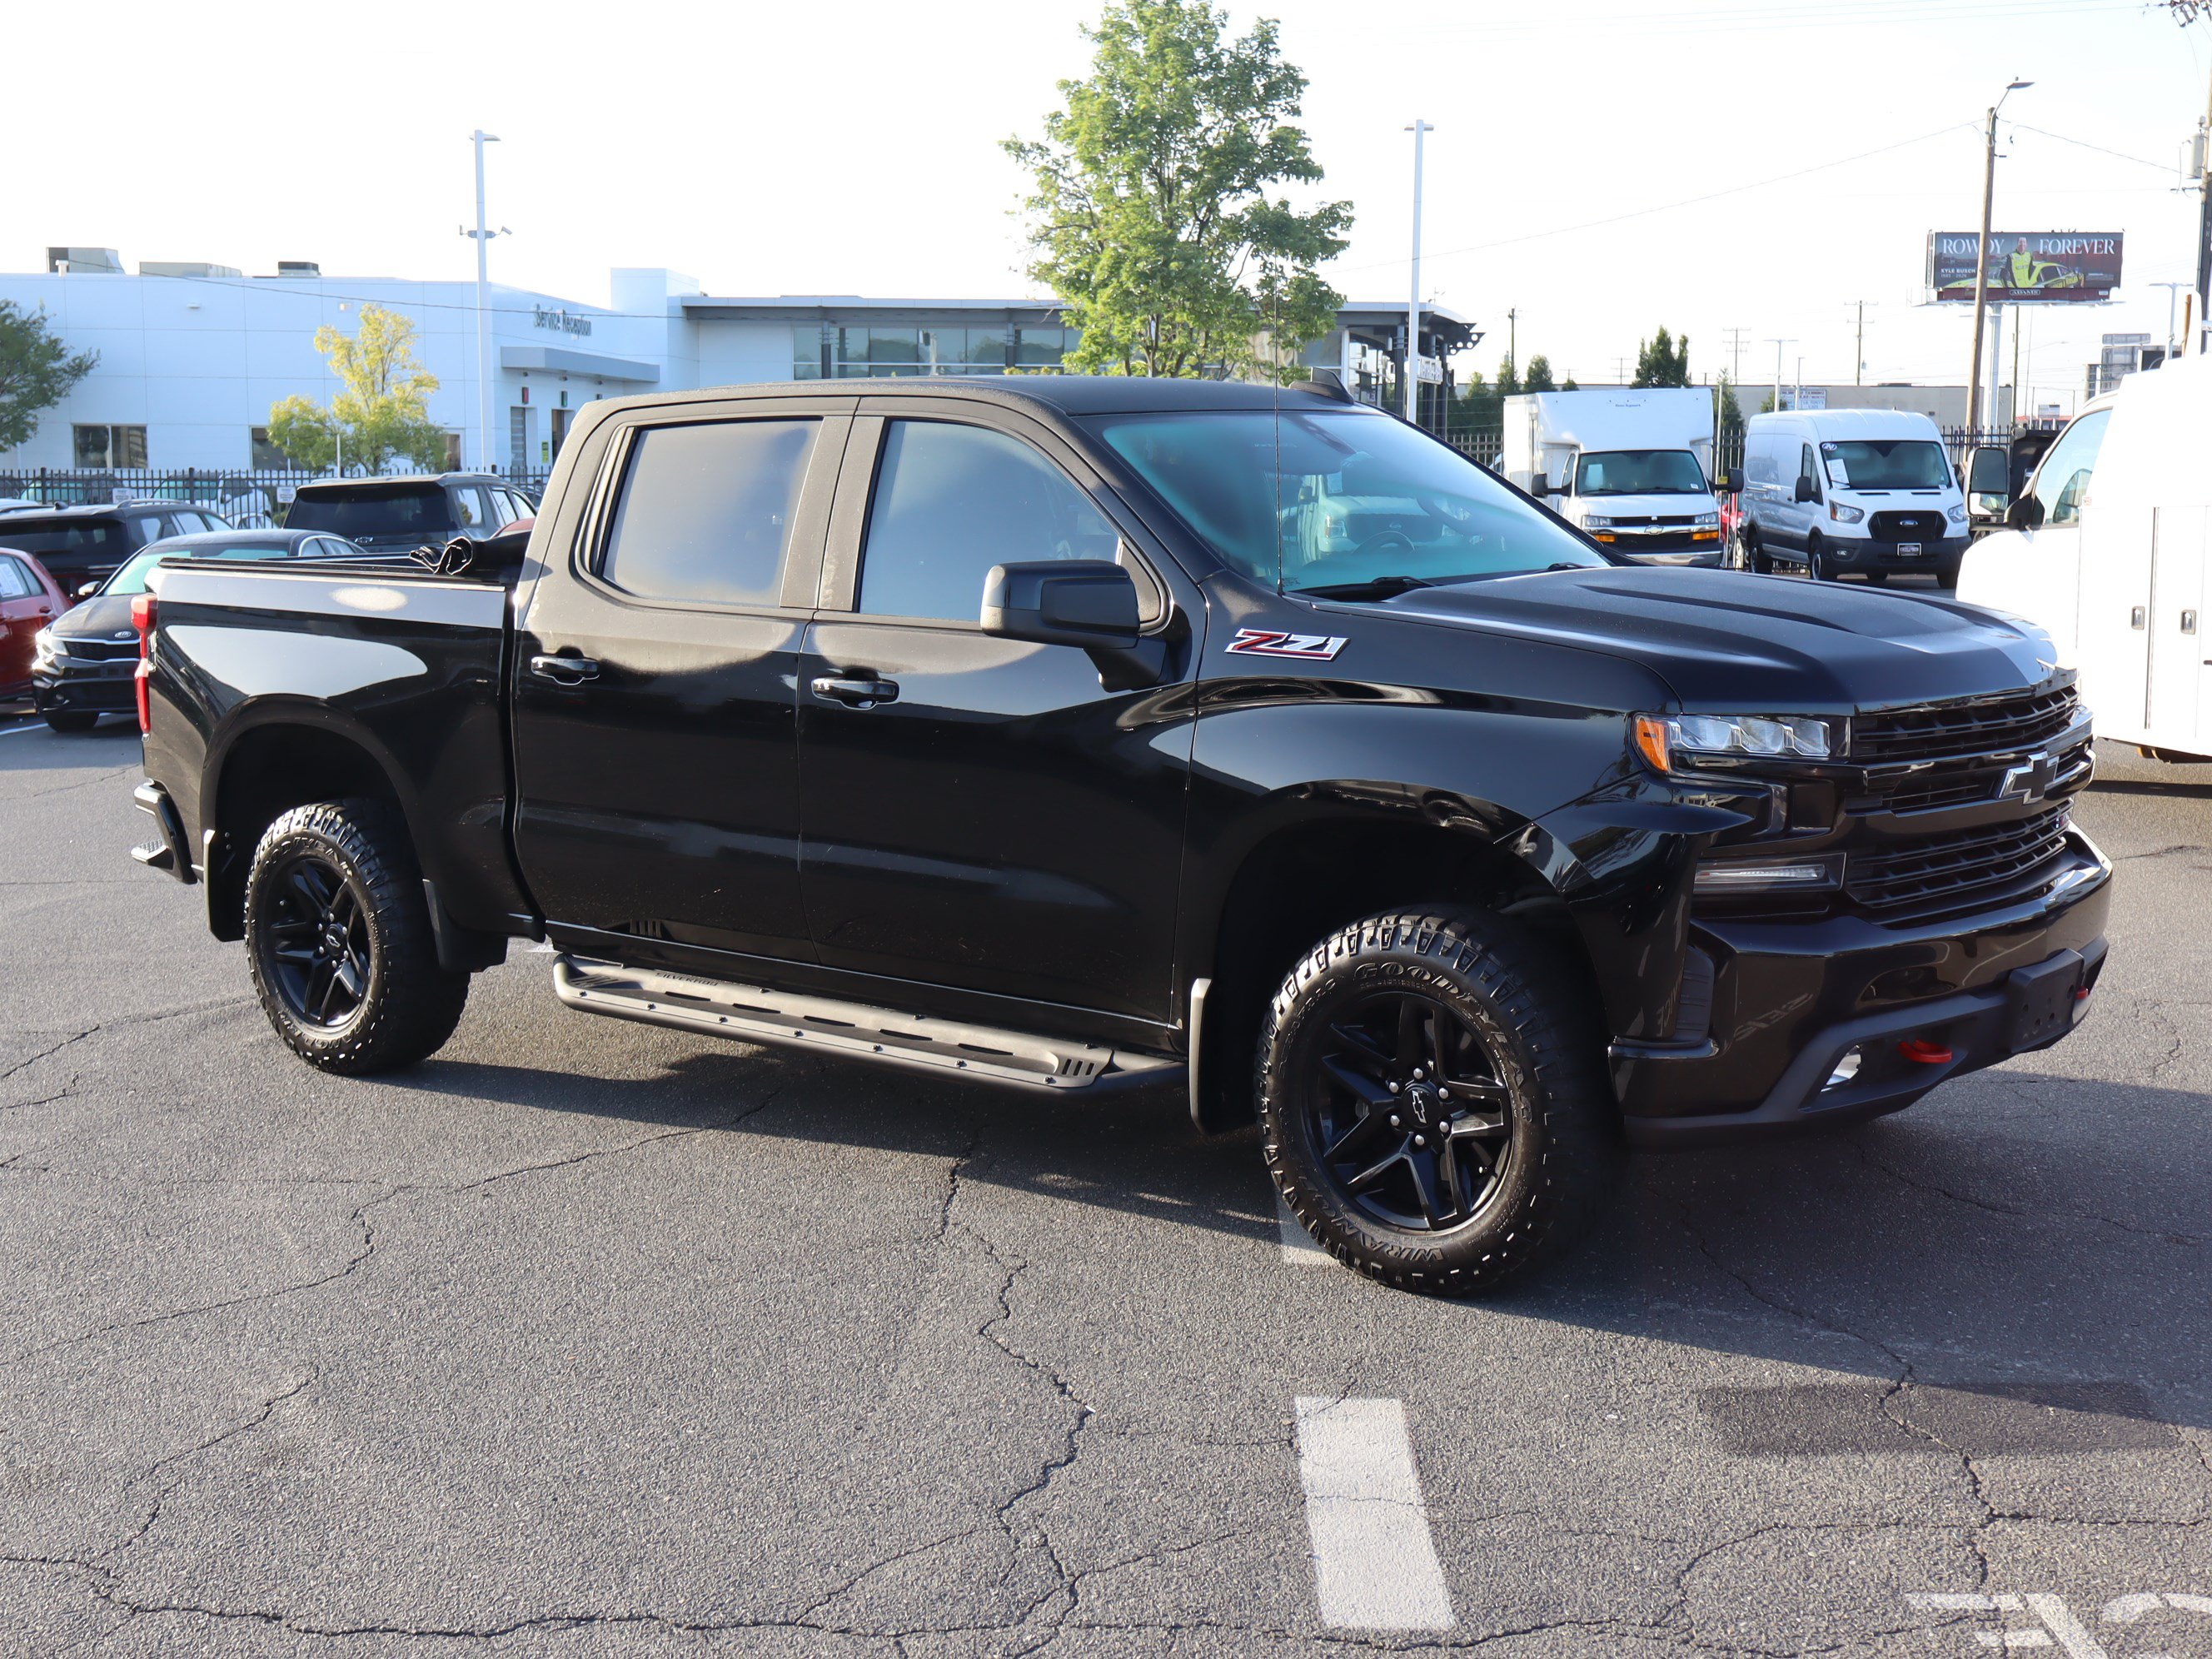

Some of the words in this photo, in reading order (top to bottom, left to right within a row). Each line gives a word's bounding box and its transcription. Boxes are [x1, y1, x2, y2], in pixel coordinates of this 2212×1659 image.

[2040, 238, 2115, 255] FOREVER
[534, 303, 560, 331] Service
[562, 309, 592, 340] Reception
[1224, 628, 1349, 661] Z71
